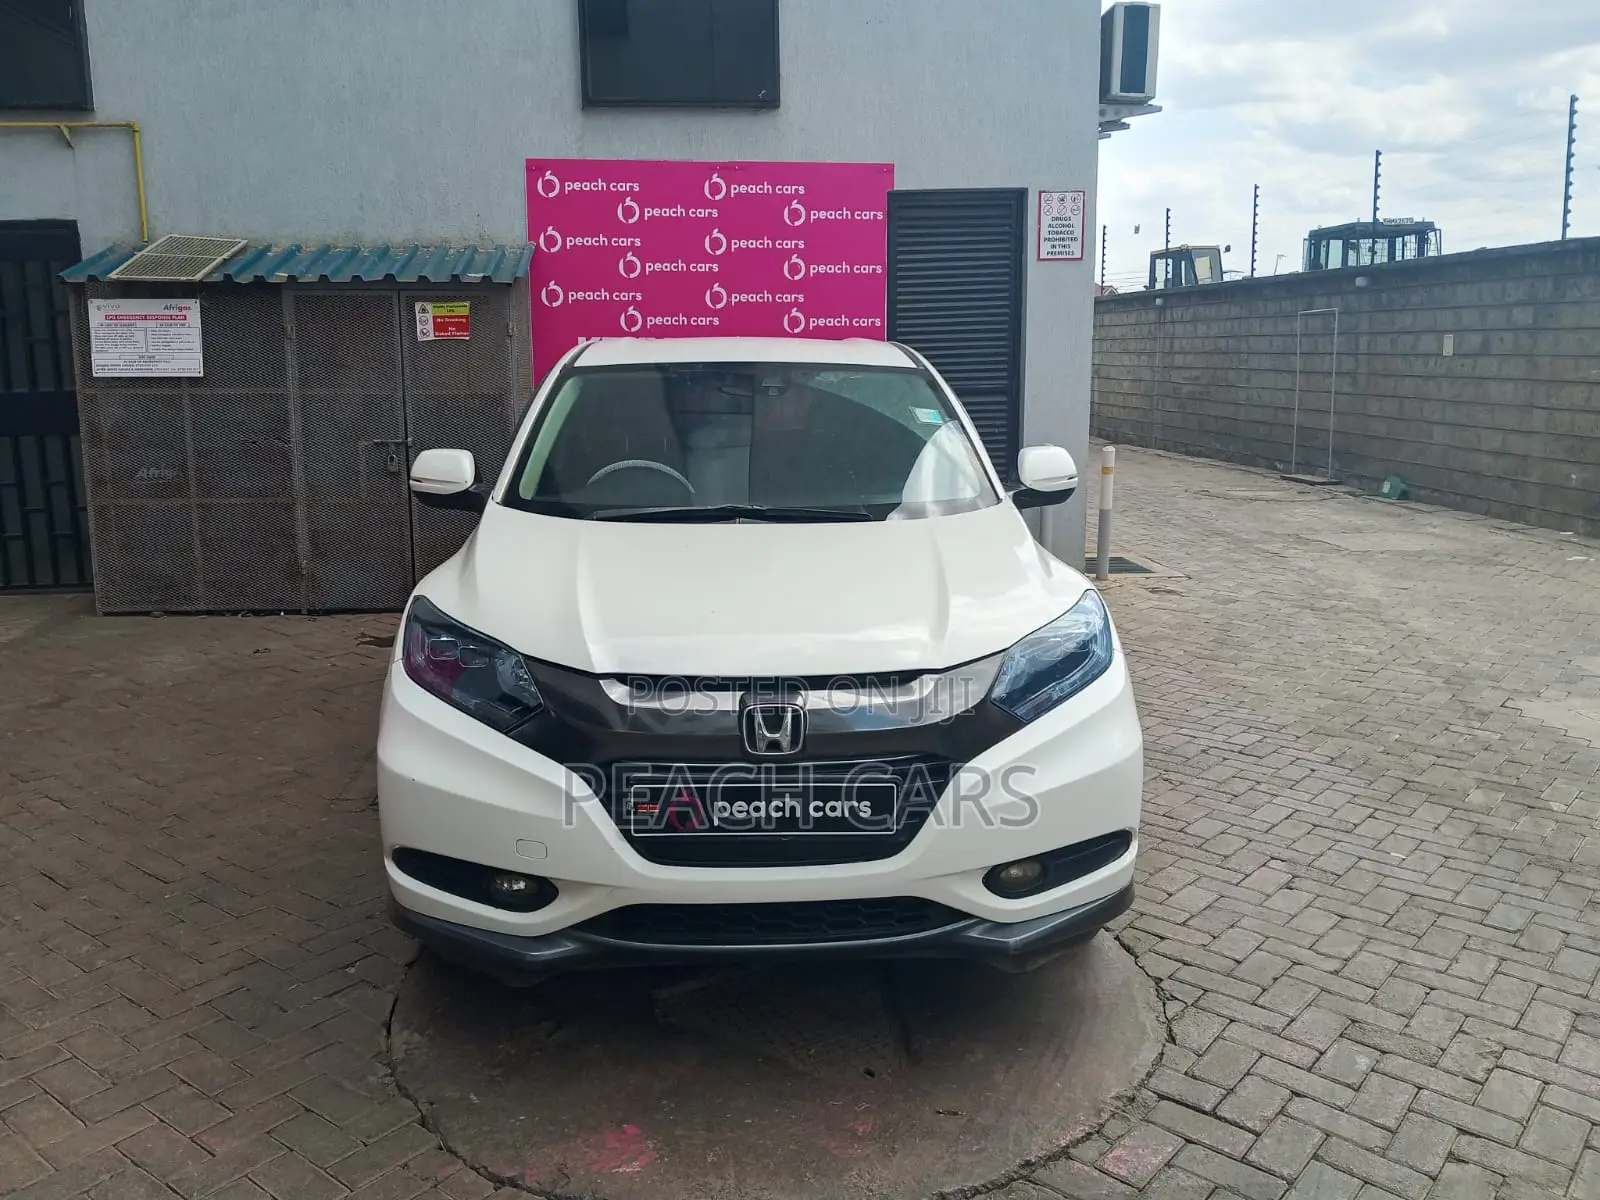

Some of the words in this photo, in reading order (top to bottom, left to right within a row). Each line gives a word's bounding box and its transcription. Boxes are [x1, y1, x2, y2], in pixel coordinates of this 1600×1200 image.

[565, 178, 606, 194] peach
[610, 181, 640, 192] cars
[731, 181, 772, 197] peach
[776, 184, 805, 194] cars
[644, 205, 685, 220] peach
[689, 208, 718, 217] cars
[811, 207, 851, 223] peach
[854, 210, 883, 220] cars
[567, 234, 608, 249] peach
[611, 237, 641, 247] cars
[732, 236, 772, 252] peach
[776, 239, 805, 249] cars
[646, 260, 686, 275] peach
[690, 262, 719, 272] cars
[810, 261, 850, 276] peach
[854, 264, 882, 274] cars
[569, 288, 610, 303] peach
[613, 291, 642, 301] cars
[732, 290, 772, 305] peach
[776, 293, 804, 302] cars
[647, 313, 687, 328] peach
[691, 316, 719, 326] cars
[810, 314, 849, 330] peach
[853, 318, 881, 327] cars
[714, 793, 801, 826] peach
[809, 800, 872, 818] cars
